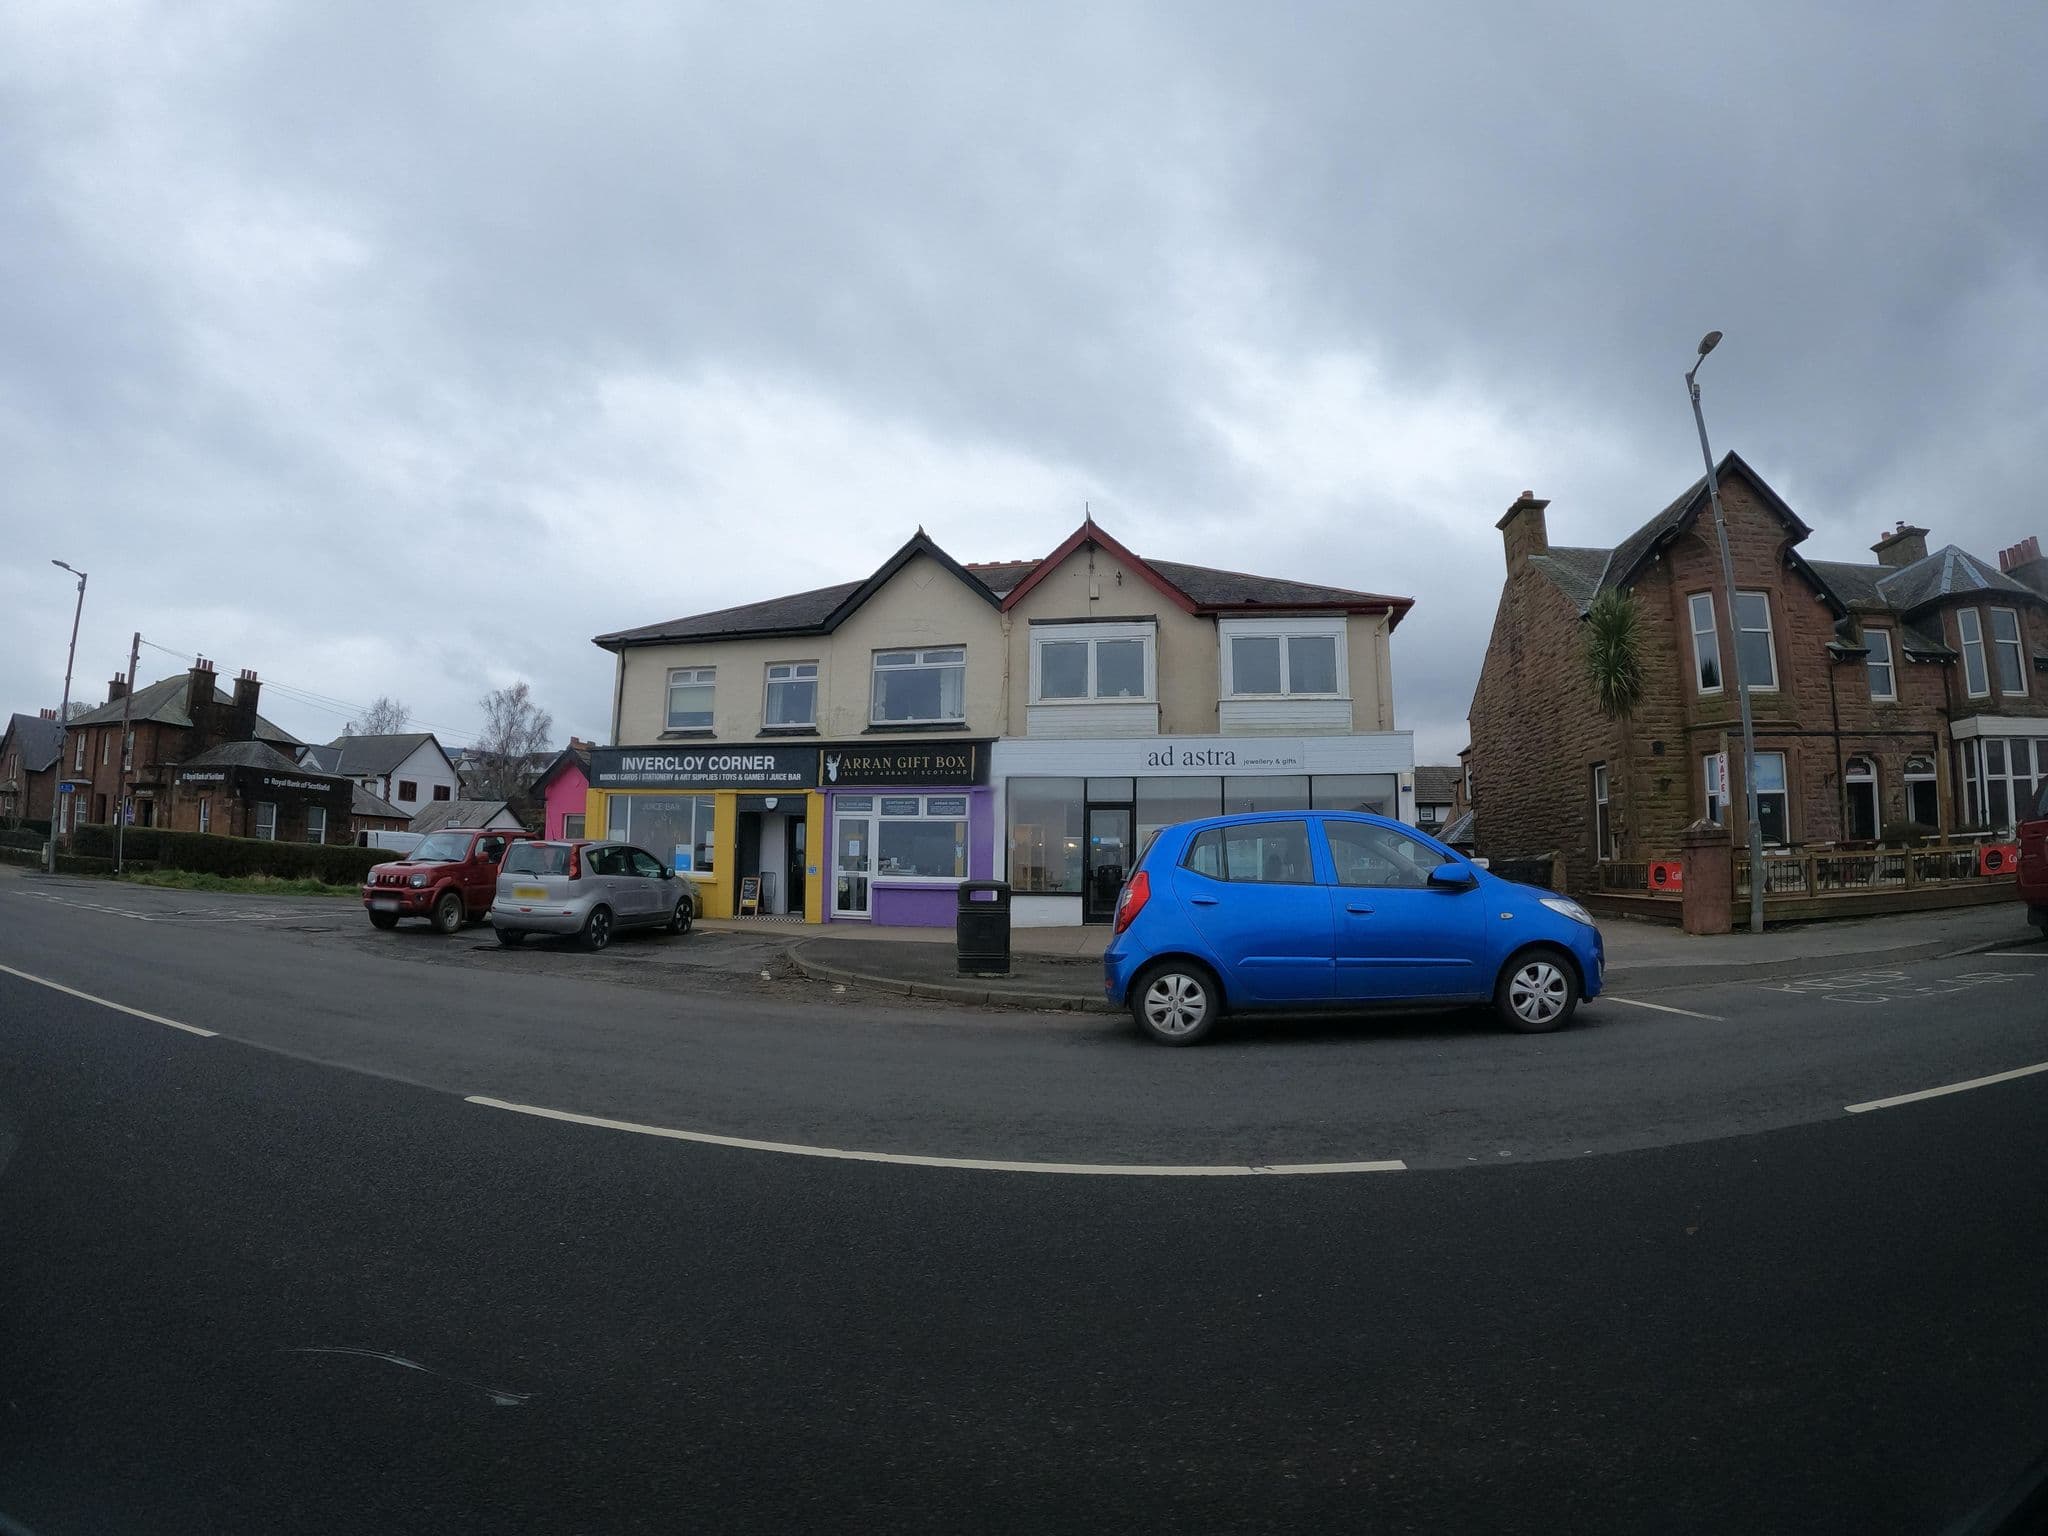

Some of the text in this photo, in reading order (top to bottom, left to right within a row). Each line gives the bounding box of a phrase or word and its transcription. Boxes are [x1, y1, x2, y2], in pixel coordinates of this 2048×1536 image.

[1147, 745, 1236, 766] ad astra
[1243, 757, 1274, 766] jewellery
[1282, 757, 1297, 766] gifts
[621, 755, 775, 771] INVERCLOY CORNER
[842, 755, 966, 769] ARRAN GIFT BOX
[271, 777, 287, 788] Royal
[691, 773, 719, 781] SUPPLIES
[722, 773, 737, 781] TOYS
[744, 773, 765, 781] GAMES
[769, 773, 787, 781] JUICE
[788, 773, 801, 781] BAR
